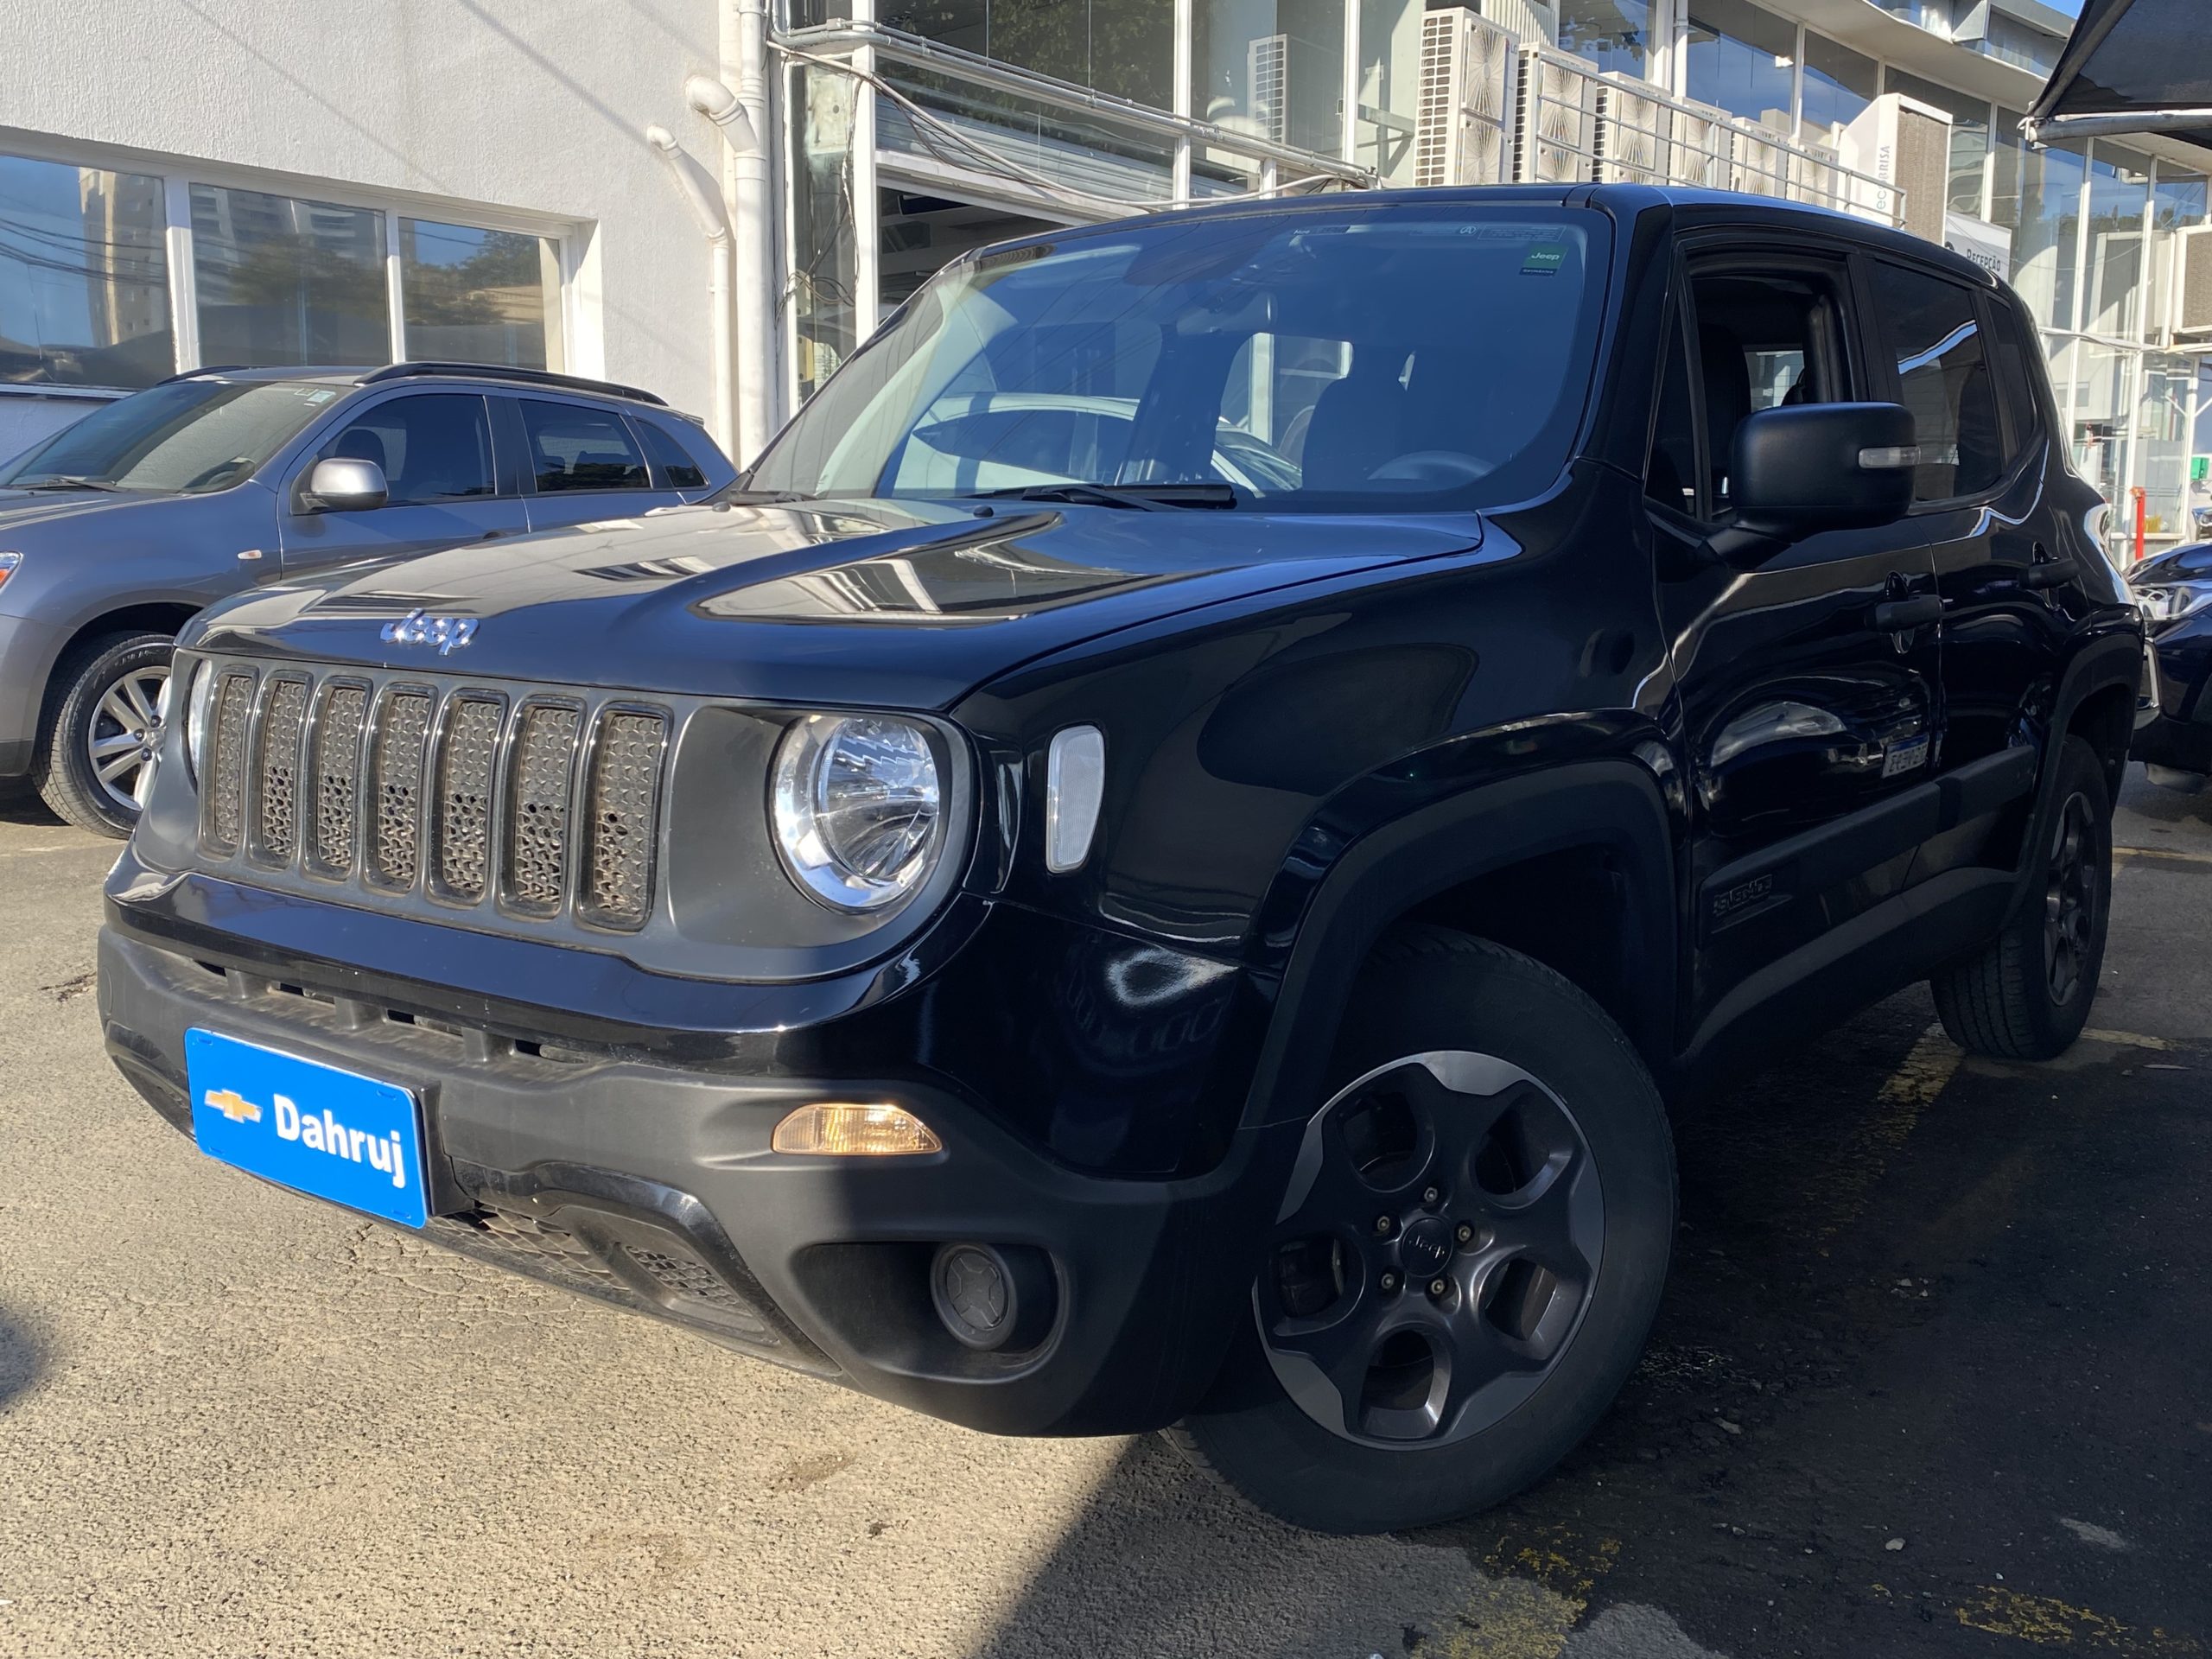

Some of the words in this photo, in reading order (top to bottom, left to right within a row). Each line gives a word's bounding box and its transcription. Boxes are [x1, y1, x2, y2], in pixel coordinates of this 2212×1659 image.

[1530, 252, 1560, 261] Jeep
[380, 607, 480, 657] Jeep
[273, 1093, 406, 1189] Dahruj
